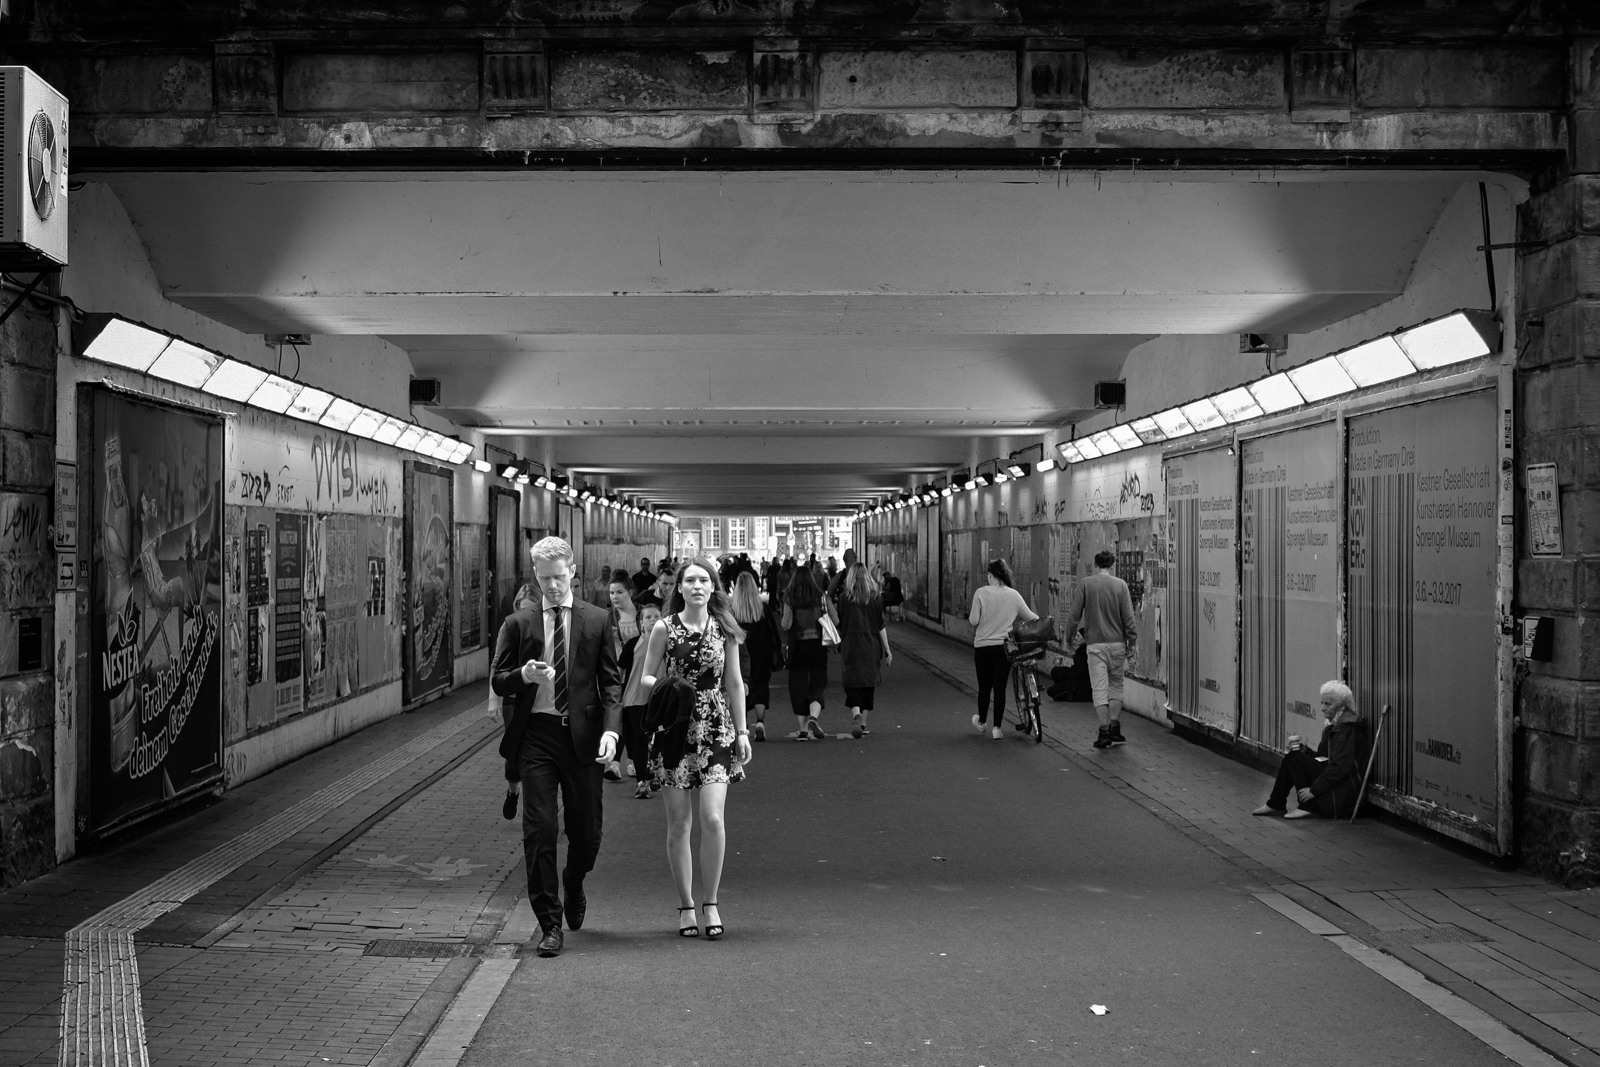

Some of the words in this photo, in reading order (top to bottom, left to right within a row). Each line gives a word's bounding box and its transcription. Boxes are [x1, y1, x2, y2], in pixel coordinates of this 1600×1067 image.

[1350, 452, 1367, 472] Made
[1367, 450, 1373, 470] in
[1373, 449, 1400, 473] Germany
[1401, 445, 1416, 467] Drei
[1416, 470, 1443, 493] Kestner
[1443, 464, 1491, 491] Gesellschaft
[1416, 497, 1457, 520] Kunstverein
[1457, 496, 1496, 519] Hannover
[1415, 525, 1447, 553] Sprengel
[1448, 525, 1481, 548] Museum
[102, 644, 140, 691] NESTEA
[141, 653, 181, 724] Freiheit
[180, 604, 205, 676] nach
[129, 726, 169, 779] deinem
[168, 611, 219, 744] Geschmack
